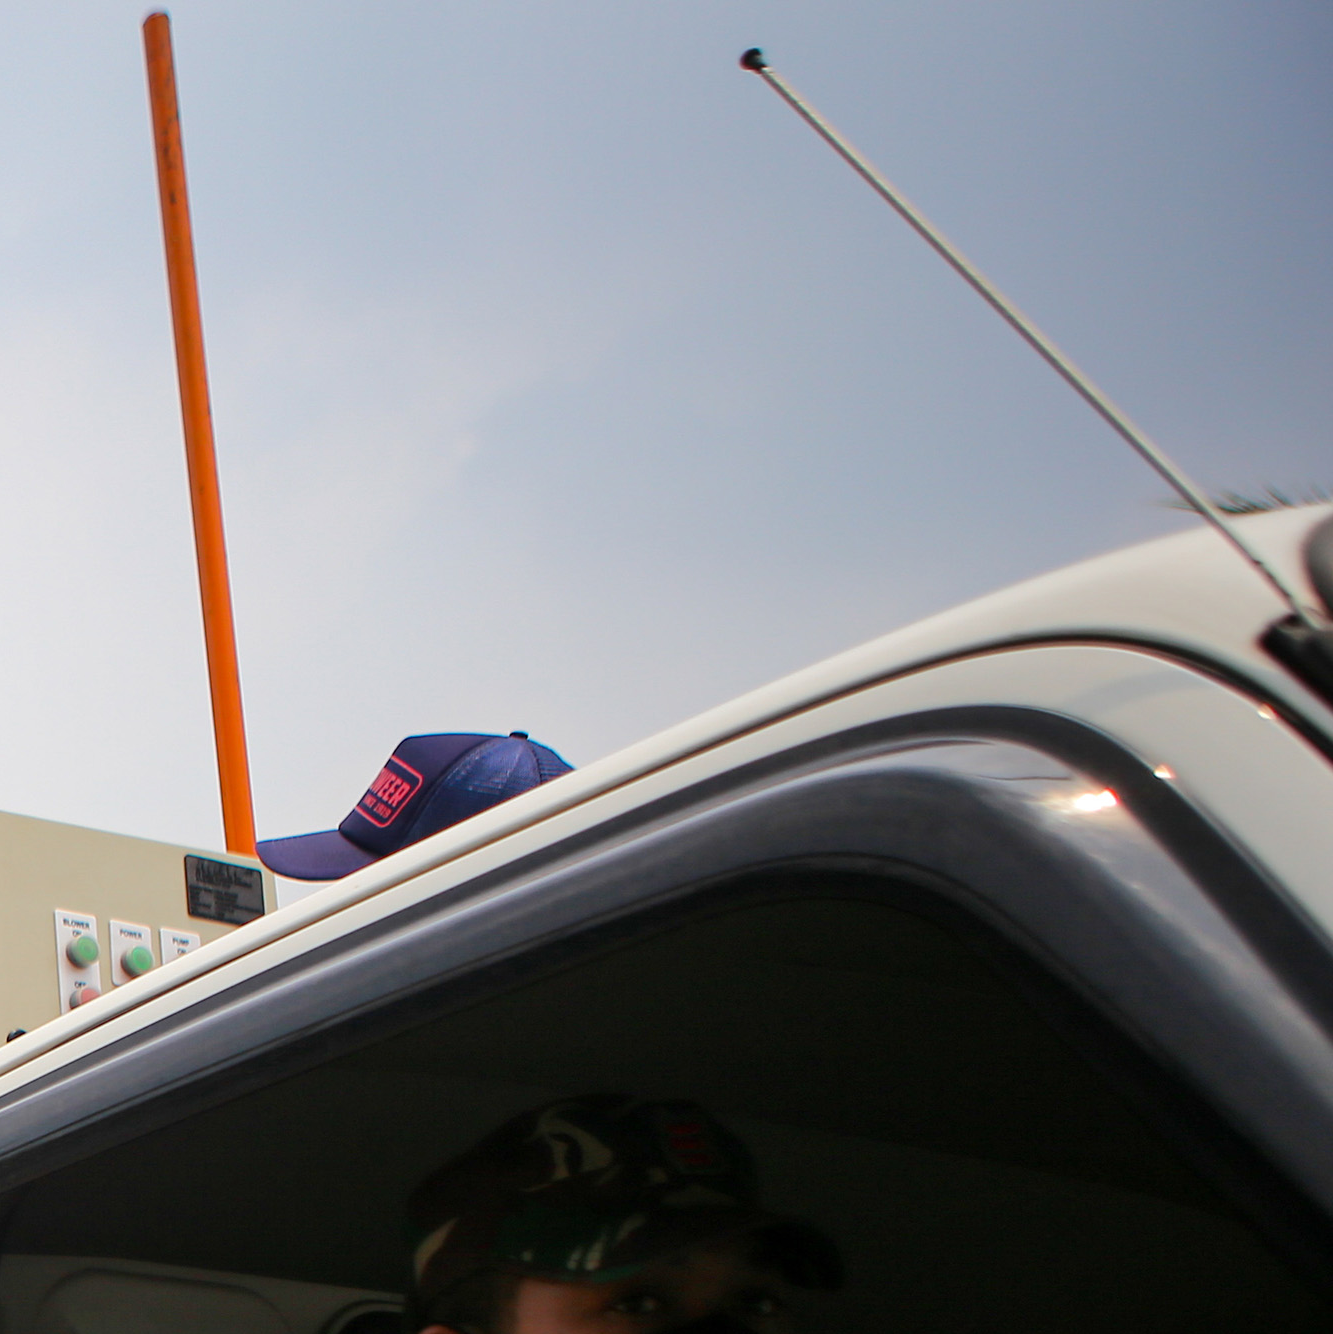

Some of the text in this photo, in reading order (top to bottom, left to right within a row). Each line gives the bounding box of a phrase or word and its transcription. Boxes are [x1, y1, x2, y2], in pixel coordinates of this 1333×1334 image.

[63, 918, 90, 929] BLOWER
[120, 928, 142, 939] POWER
[173, 937, 189, 947] PUMP
